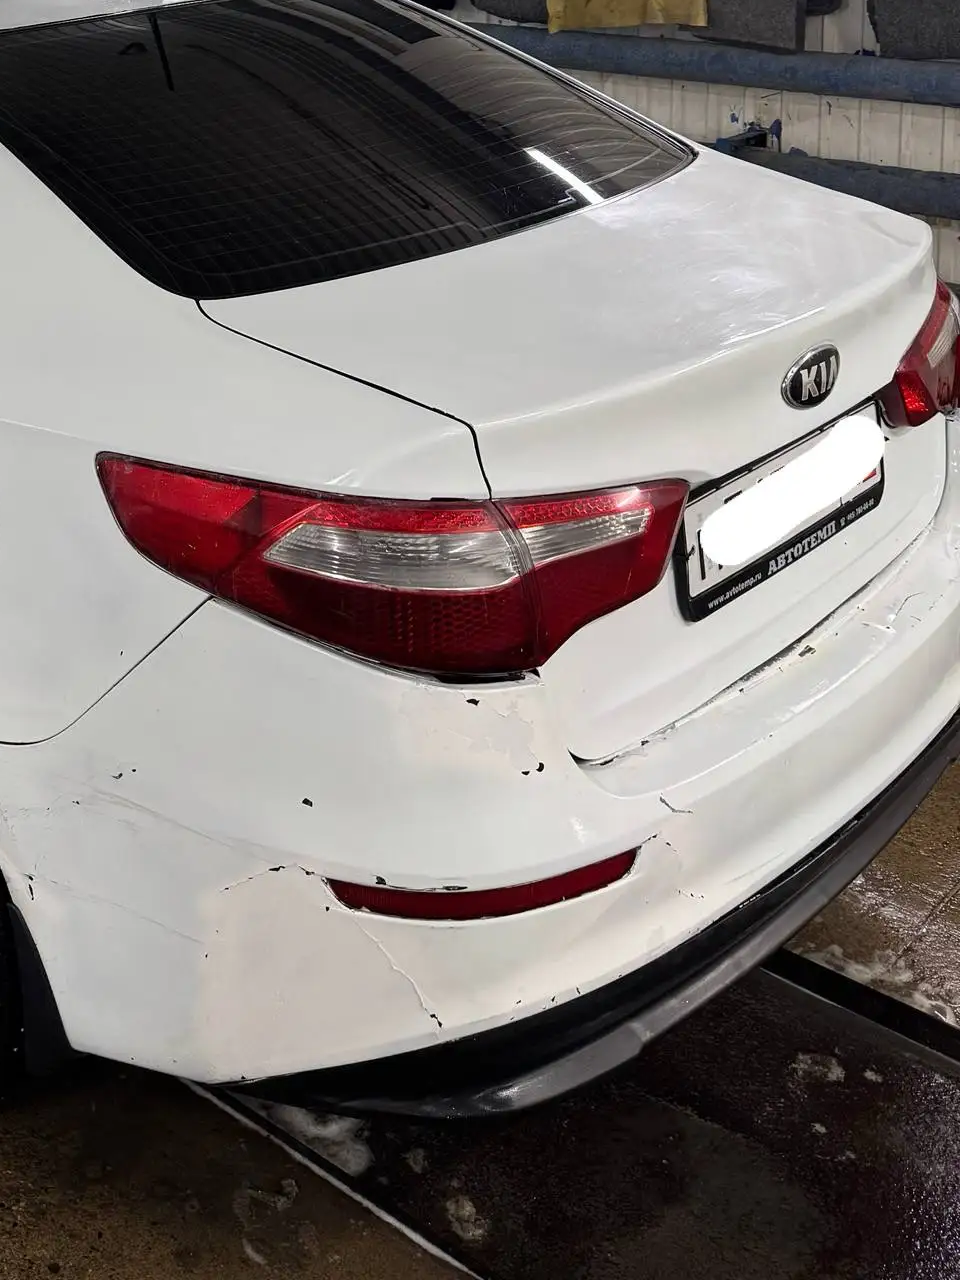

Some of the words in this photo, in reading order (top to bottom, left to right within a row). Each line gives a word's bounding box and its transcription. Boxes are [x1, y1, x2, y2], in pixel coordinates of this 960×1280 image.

[800, 355, 838, 401] KIA
[708, 572, 762, 609] www.avtotemp.ru
[767, 520, 837, 575] АВТОТЕМП
